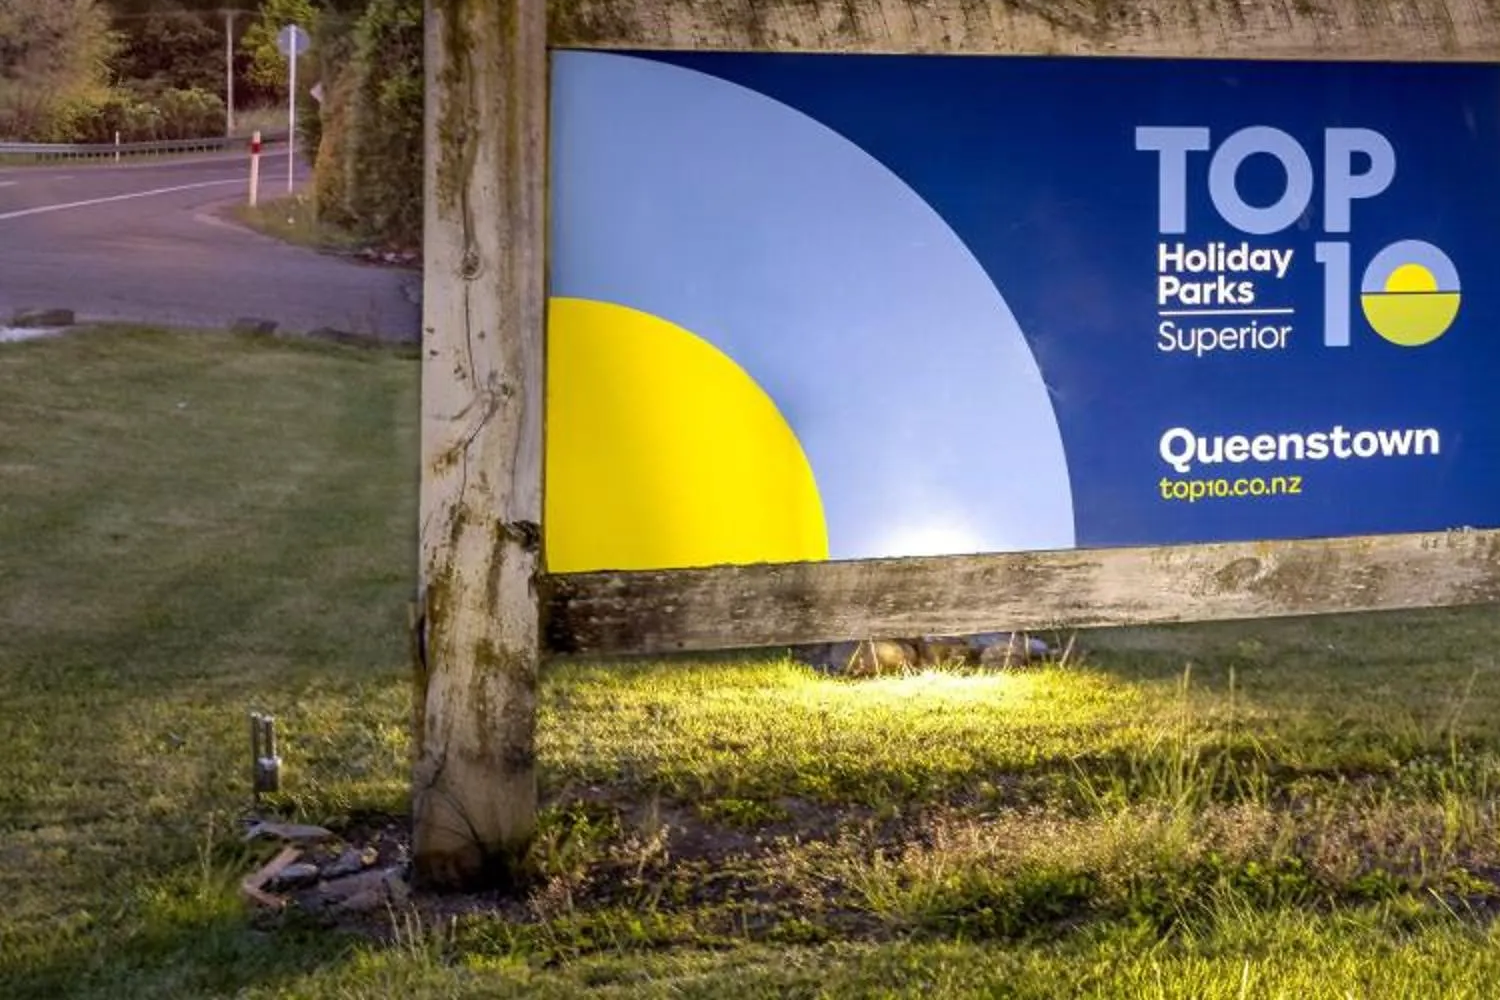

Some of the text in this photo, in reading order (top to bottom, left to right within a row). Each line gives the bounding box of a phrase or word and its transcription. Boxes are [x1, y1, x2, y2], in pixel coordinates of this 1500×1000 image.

[1135, 125, 1397, 235] TOP
[1157, 242, 1294, 279] Holiday
[1157, 275, 1255, 305] Parks
[1314, 239, 1462, 348] 10
[1157, 320, 1293, 357] Superior
[1159, 425, 1440, 473] Queenstown
[1159, 475, 1303, 502] top10.co.nz
